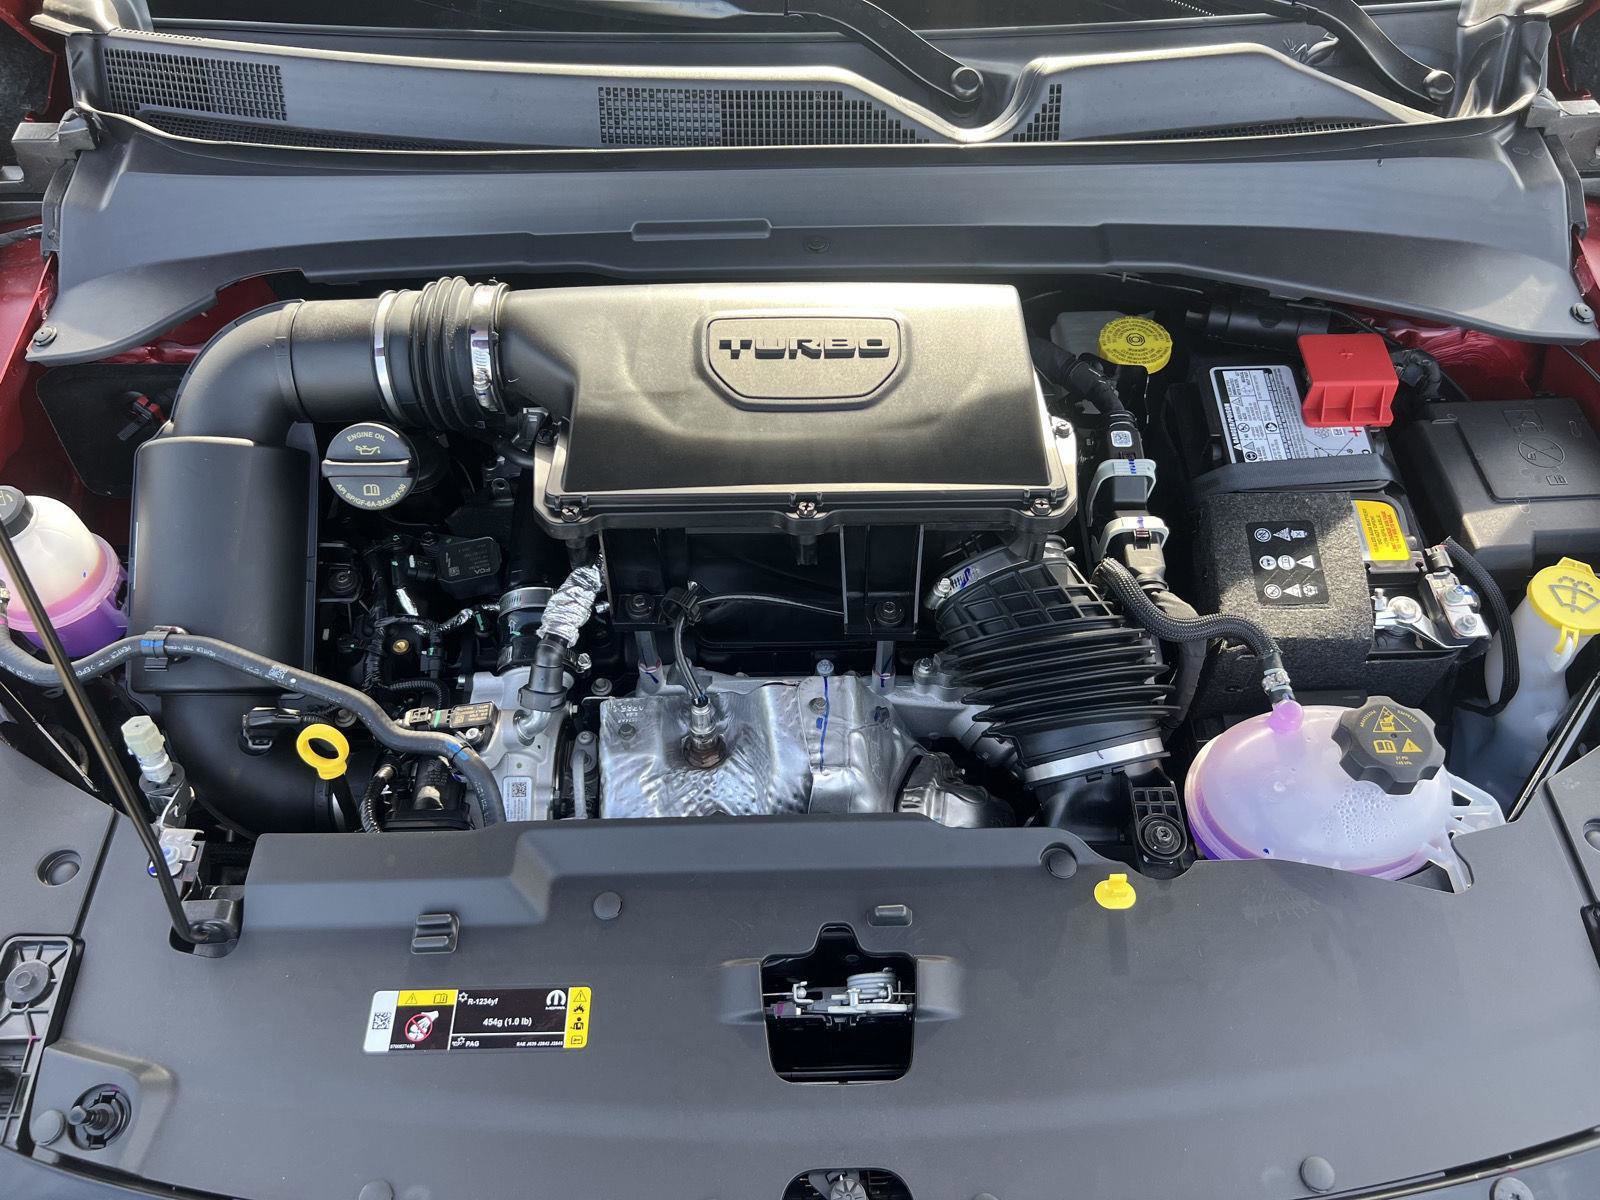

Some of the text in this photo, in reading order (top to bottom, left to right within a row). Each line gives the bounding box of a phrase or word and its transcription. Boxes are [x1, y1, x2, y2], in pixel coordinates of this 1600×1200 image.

[718, 337, 890, 359] TURBO
[346, 432, 386, 442] ENGINE OIL
[468, 997, 498, 1006] R-1234yf
[482, 1016, 532, 1027] 454g (1.0 lb)
